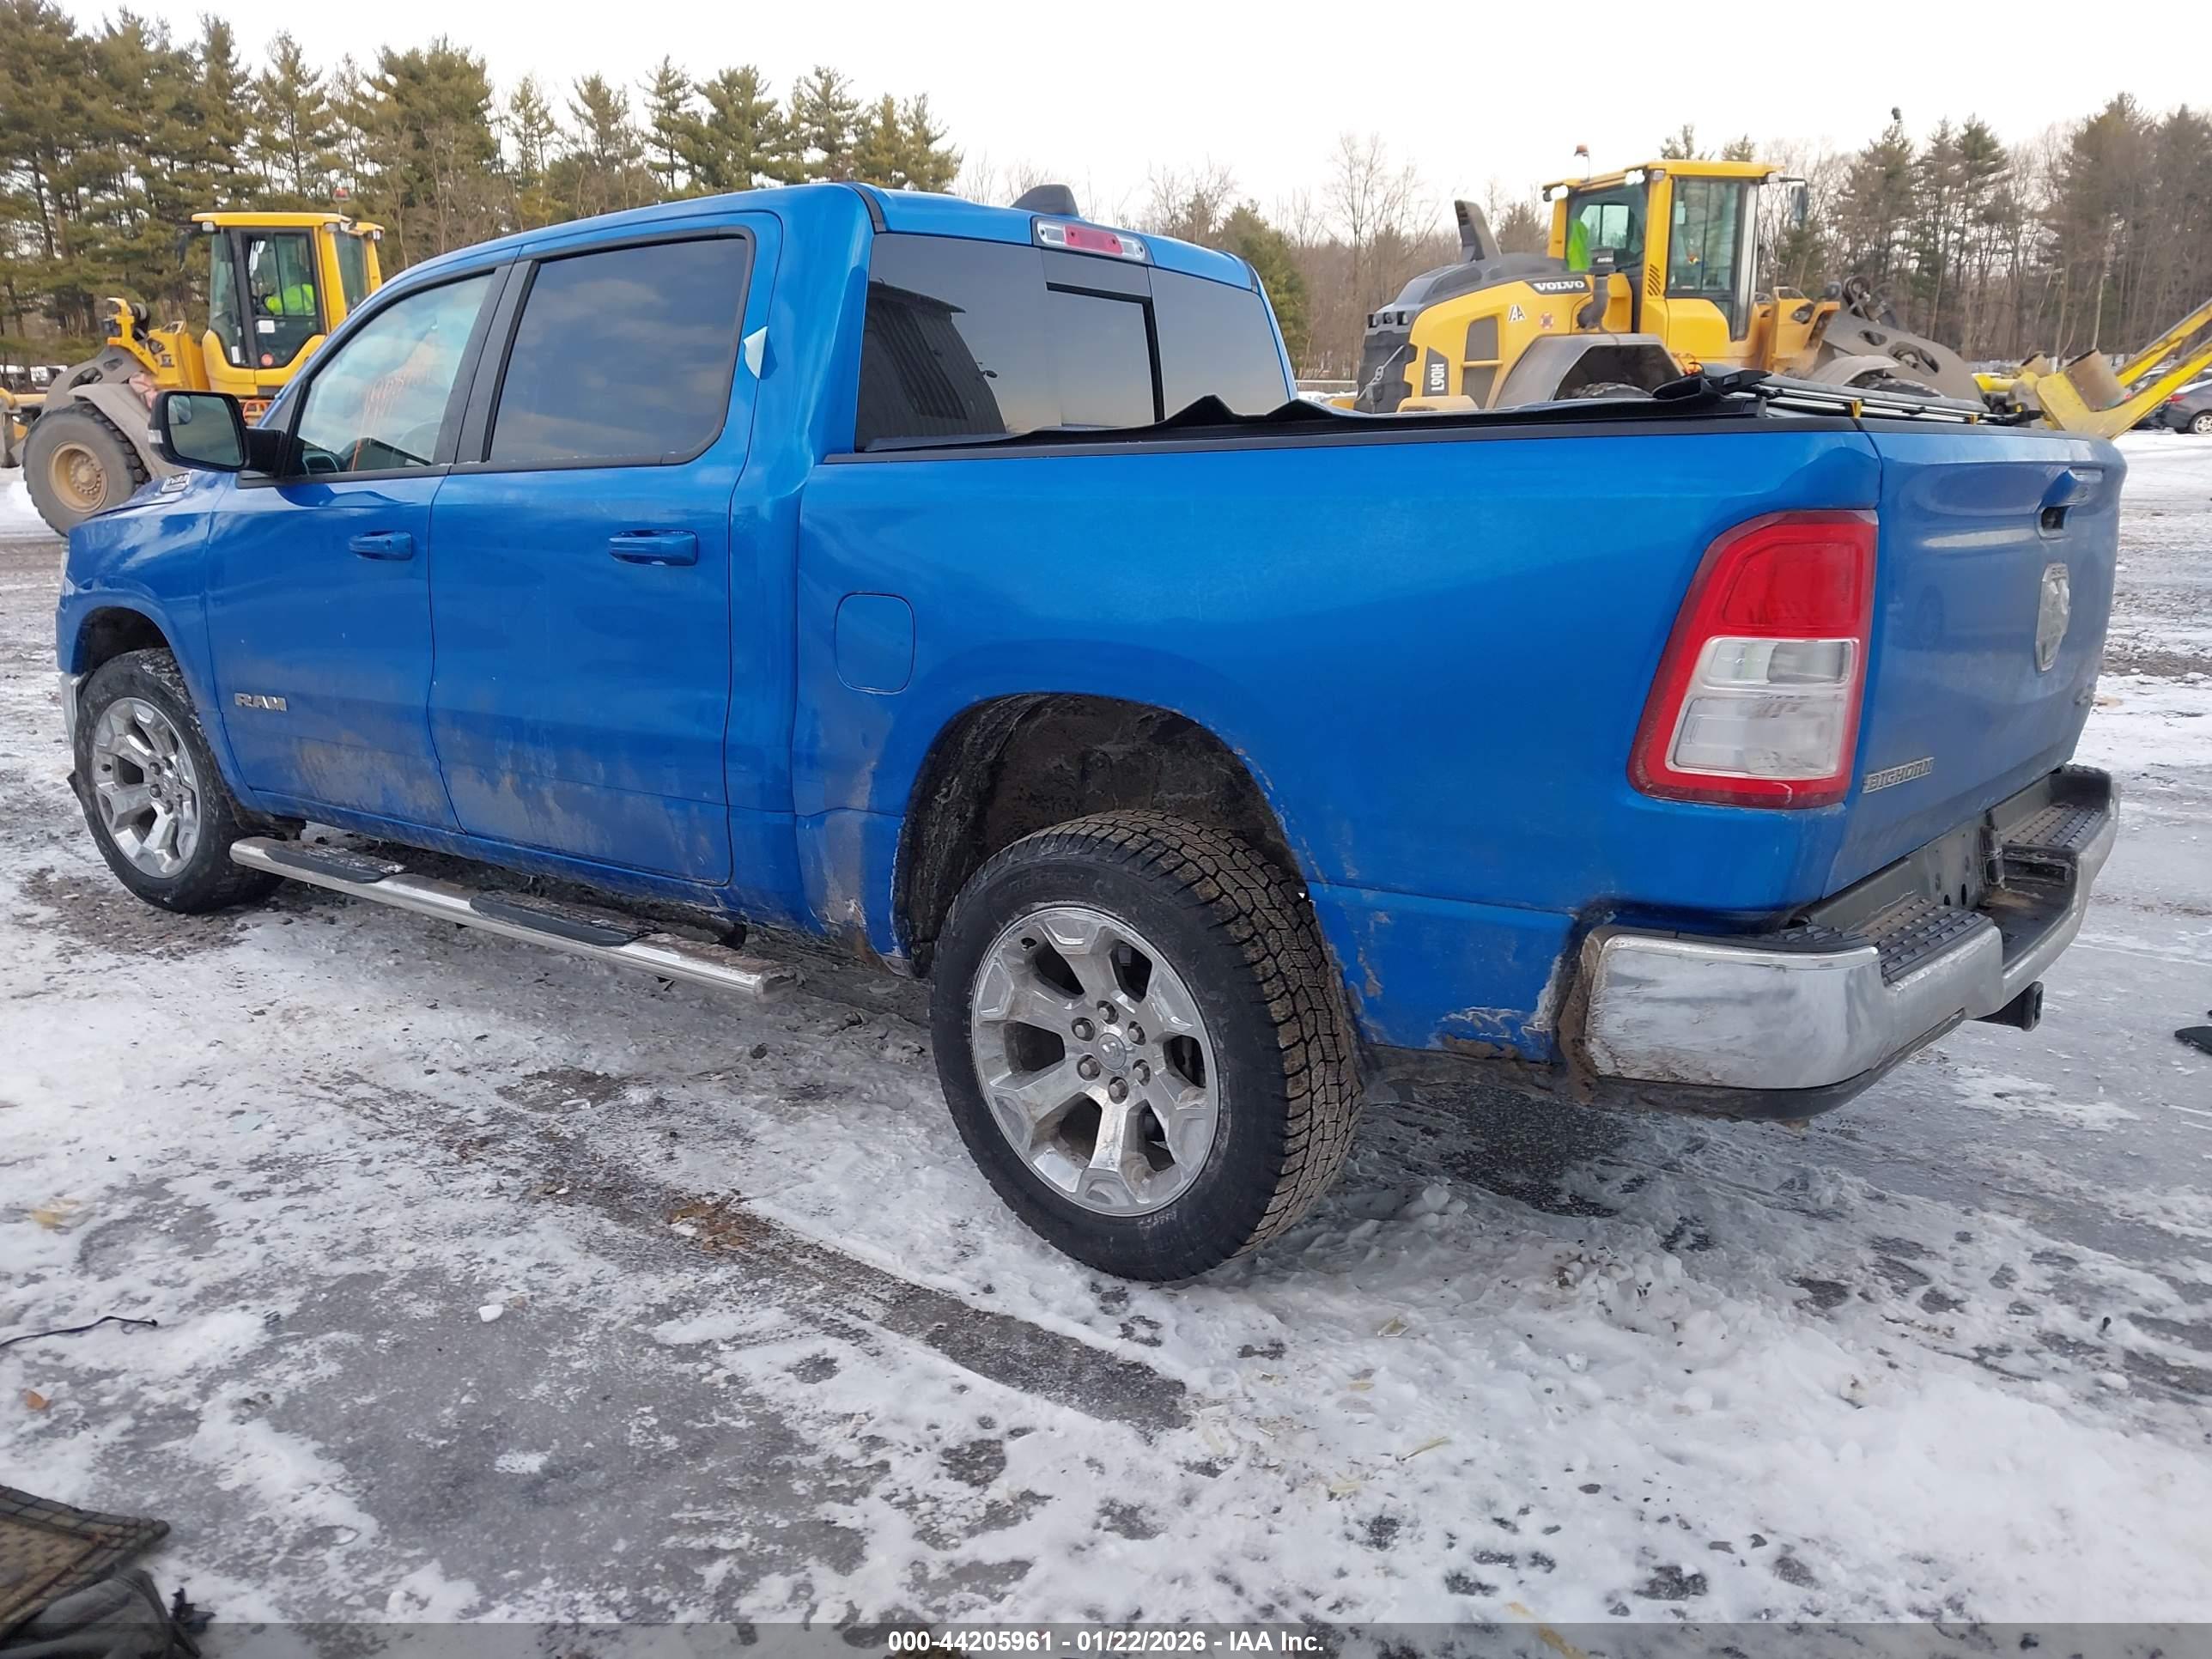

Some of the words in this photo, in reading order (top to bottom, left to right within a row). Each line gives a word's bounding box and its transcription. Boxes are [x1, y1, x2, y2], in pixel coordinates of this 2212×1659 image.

[1533, 280, 1585, 291] VOLVO
[1430, 363, 1445, 391] L90H
[234, 692, 288, 712] RAM
